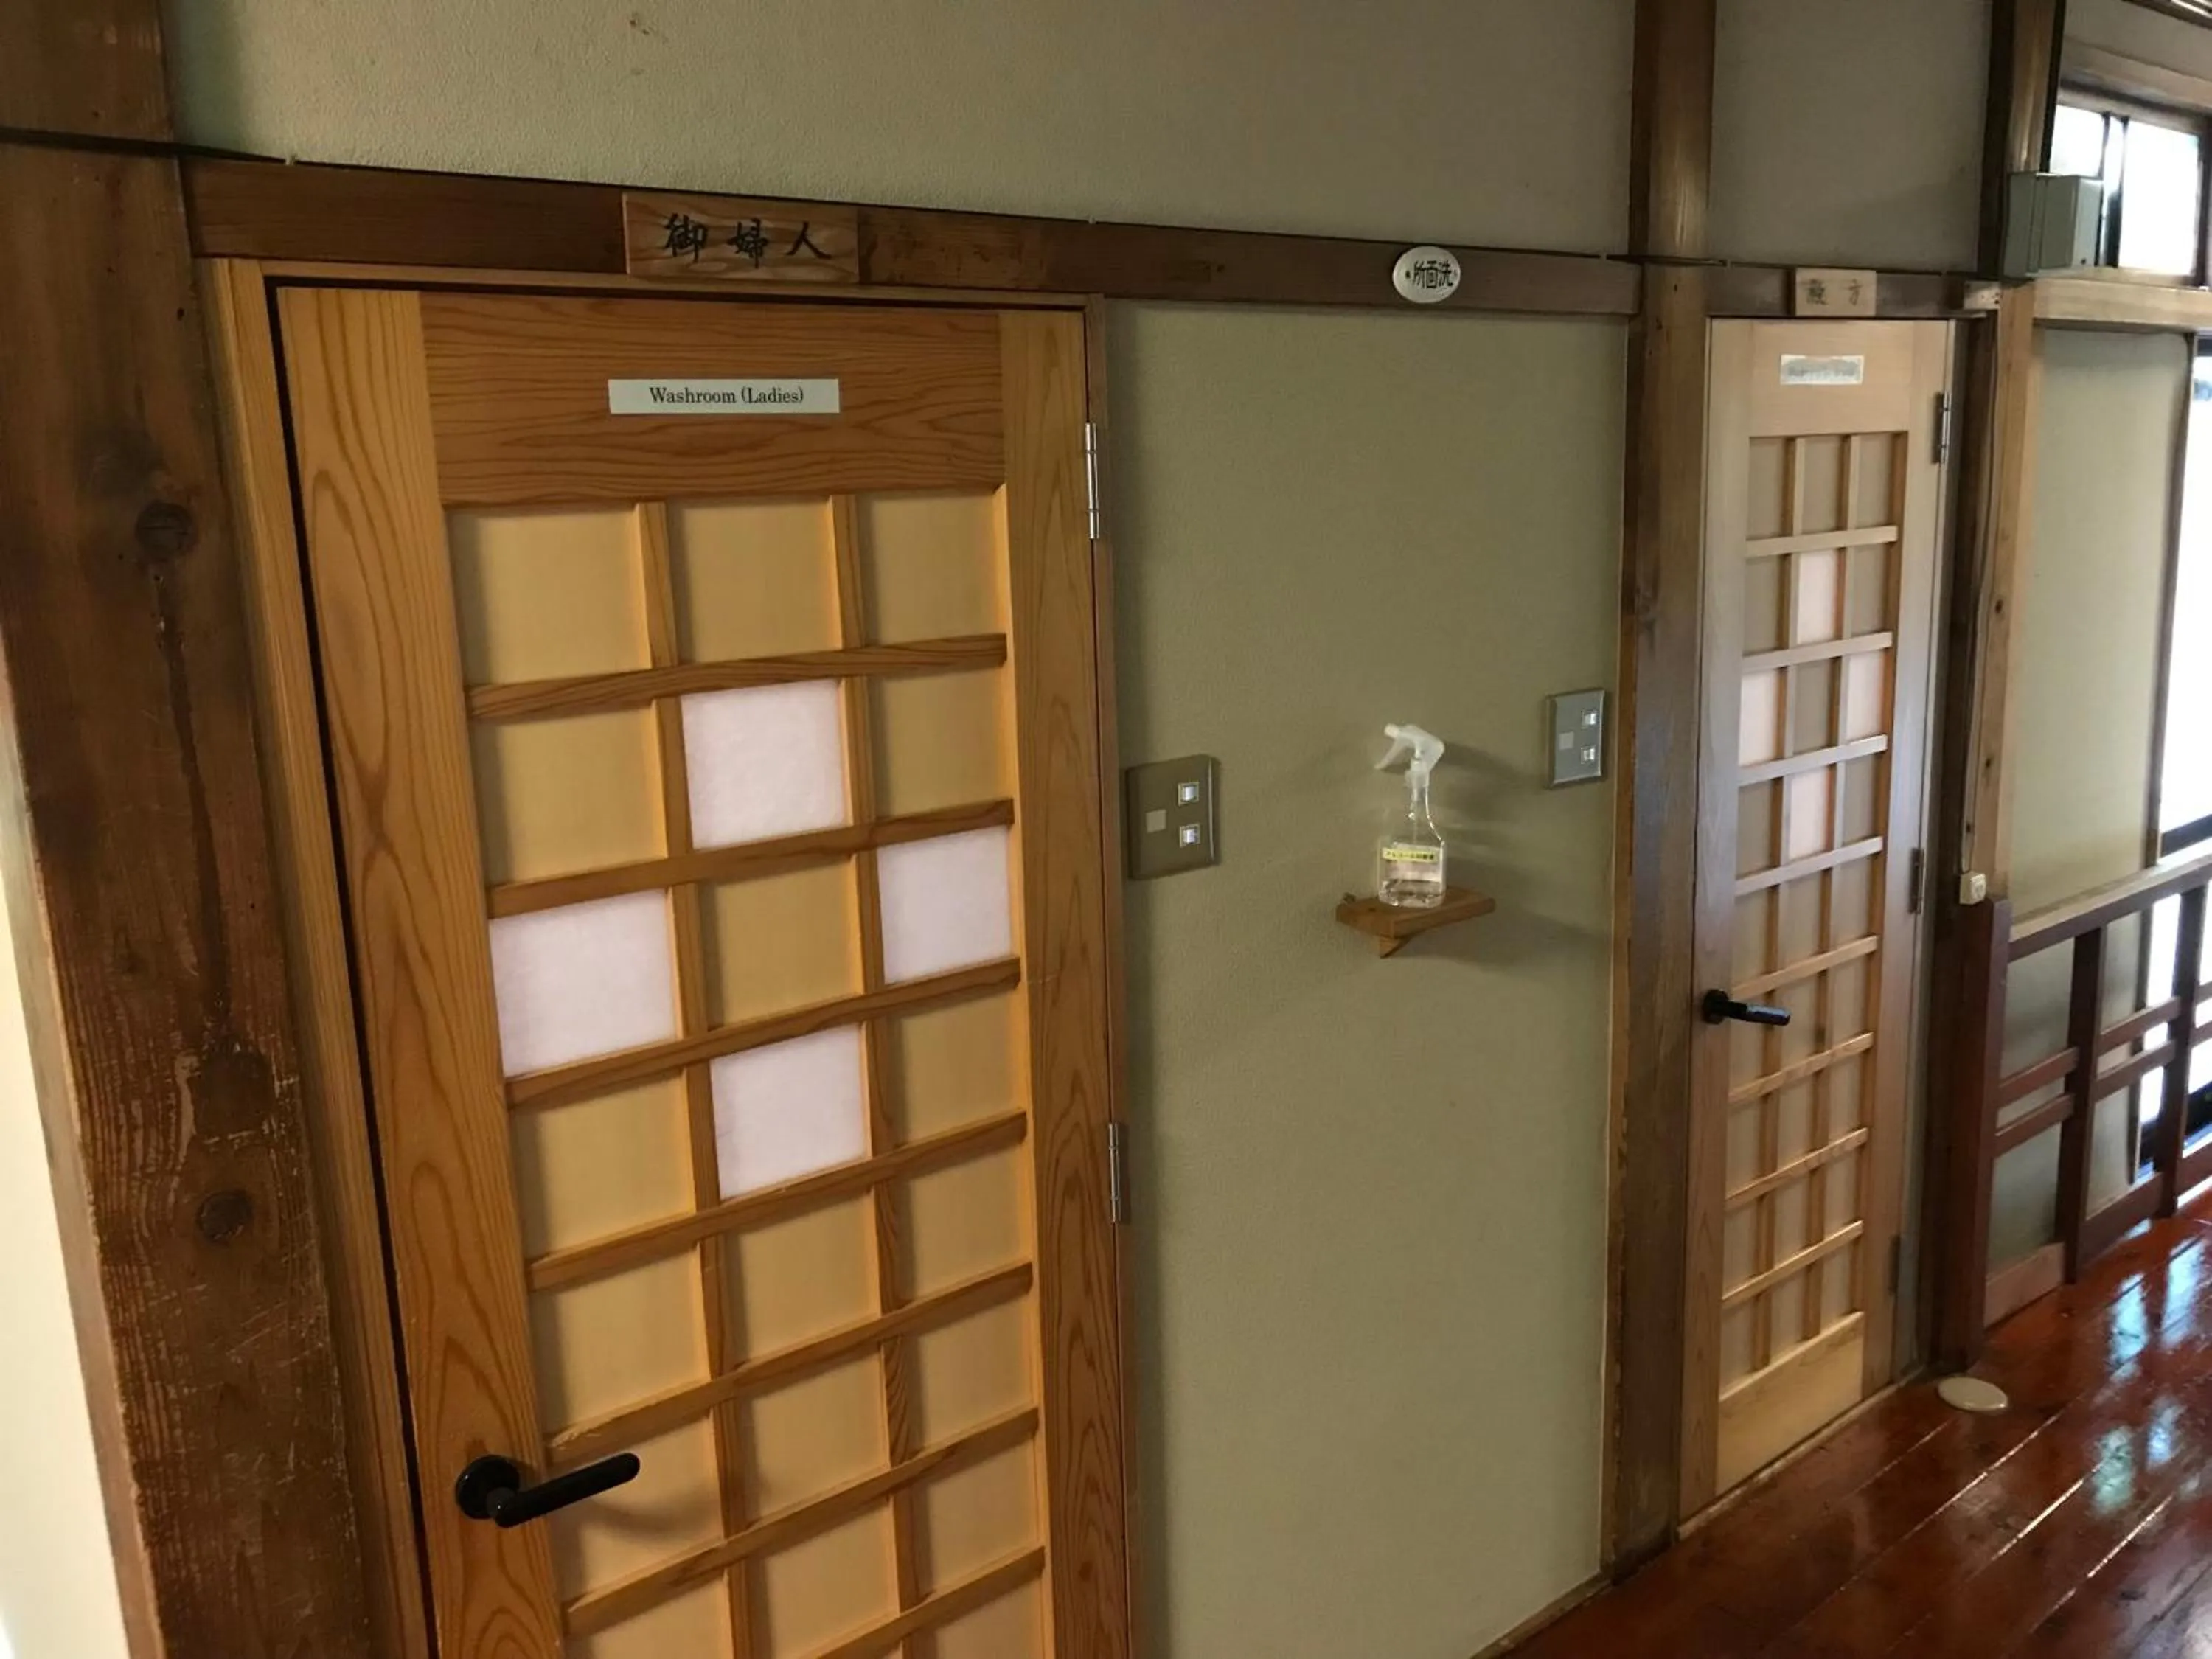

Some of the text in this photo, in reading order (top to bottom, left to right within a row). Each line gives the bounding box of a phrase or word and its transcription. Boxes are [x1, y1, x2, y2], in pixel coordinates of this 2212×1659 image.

[664, 212, 832, 268] 御婦人
[649, 386, 804, 403] Washroom (Ladies)
